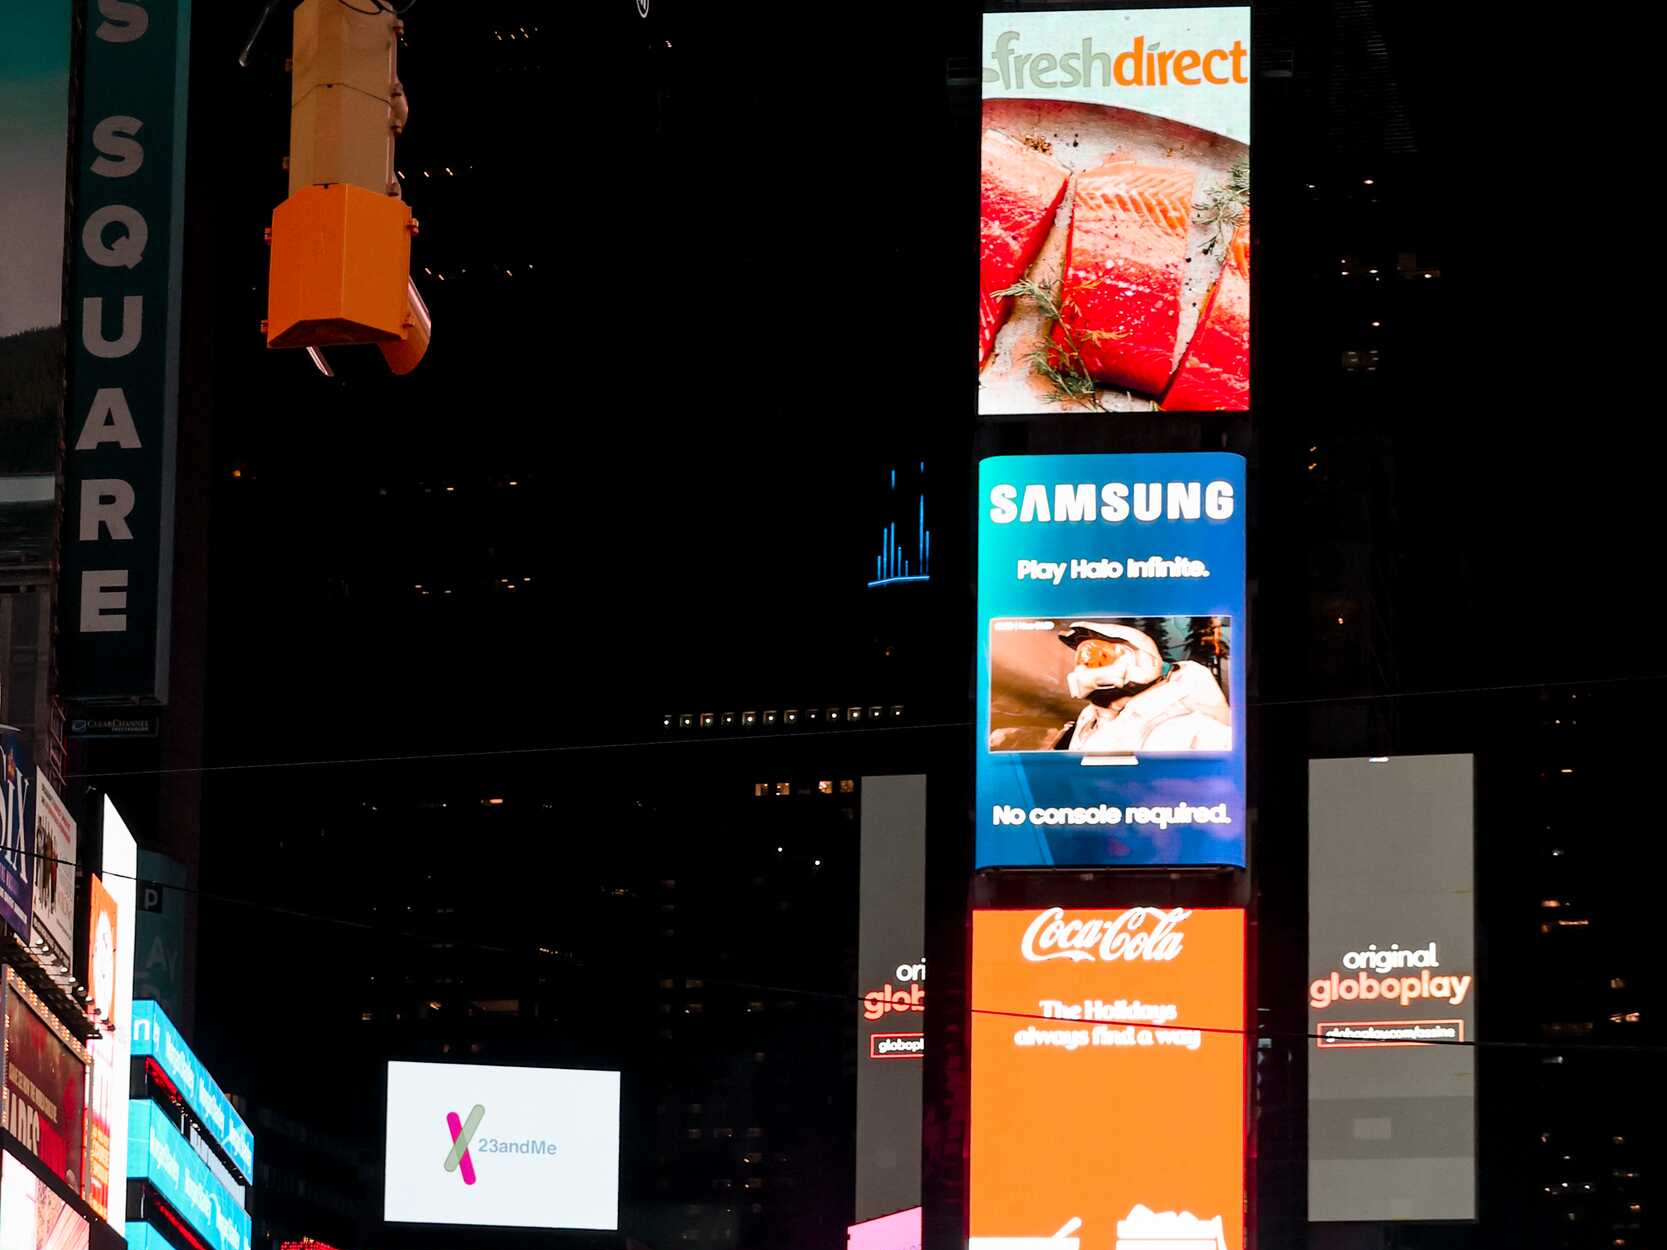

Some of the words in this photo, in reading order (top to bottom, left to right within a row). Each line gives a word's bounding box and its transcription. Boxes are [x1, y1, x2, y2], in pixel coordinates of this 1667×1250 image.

[991, 31, 1249, 90] freshdirect
[75, 115, 149, 632] SQUARE
[989, 480, 1235, 524] SAMSUNG
[1017, 560, 1066, 585] Play
[1070, 558, 1123, 580] Halo
[1127, 556, 1210, 579] Infinite.
[992, 805, 1026, 825] No
[1030, 803, 1122, 825] console
[1125, 802, 1232, 829] required.
[1021, 907, 1191, 962] Coca-Cola
[896, 958, 926, 981] ori
[1343, 942, 1439, 974] original
[1310, 970, 1472, 1009] globoplay
[1039, 1001, 1081, 1021] The
[1084, 1001, 1177, 1025] Holidays
[1014, 1027, 1089, 1050] always
[1092, 1027, 1135, 1047] find
[1136, 1030, 1153, 1047] a
[1154, 1030, 1201, 1050] way
[478, 1138, 558, 1156] 23andMe
